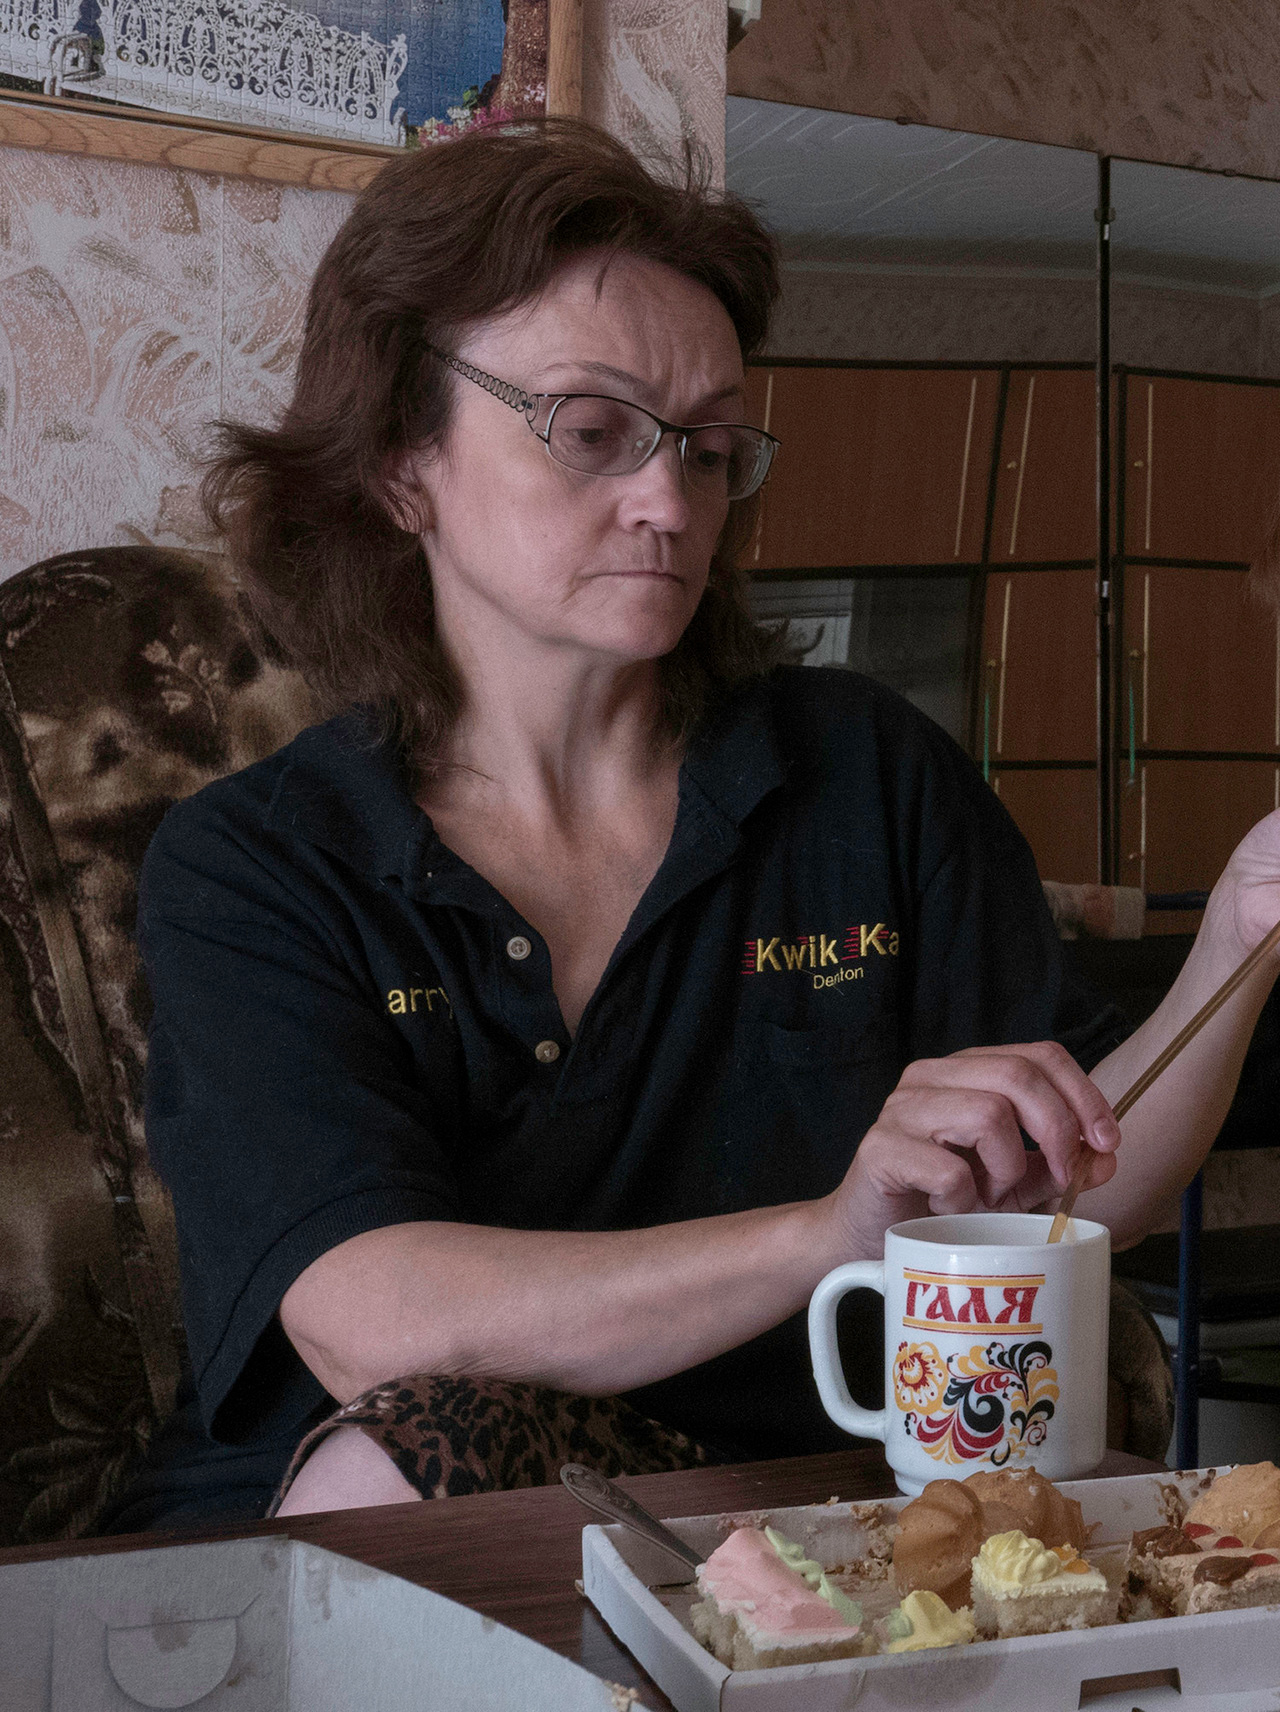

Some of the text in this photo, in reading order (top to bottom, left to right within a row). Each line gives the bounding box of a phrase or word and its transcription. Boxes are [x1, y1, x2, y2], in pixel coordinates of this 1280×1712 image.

[756, 935, 839, 972] Kwik
[813, 964, 864, 990] Denton
[904, 1281, 1039, 1323] ГАЛЯ
